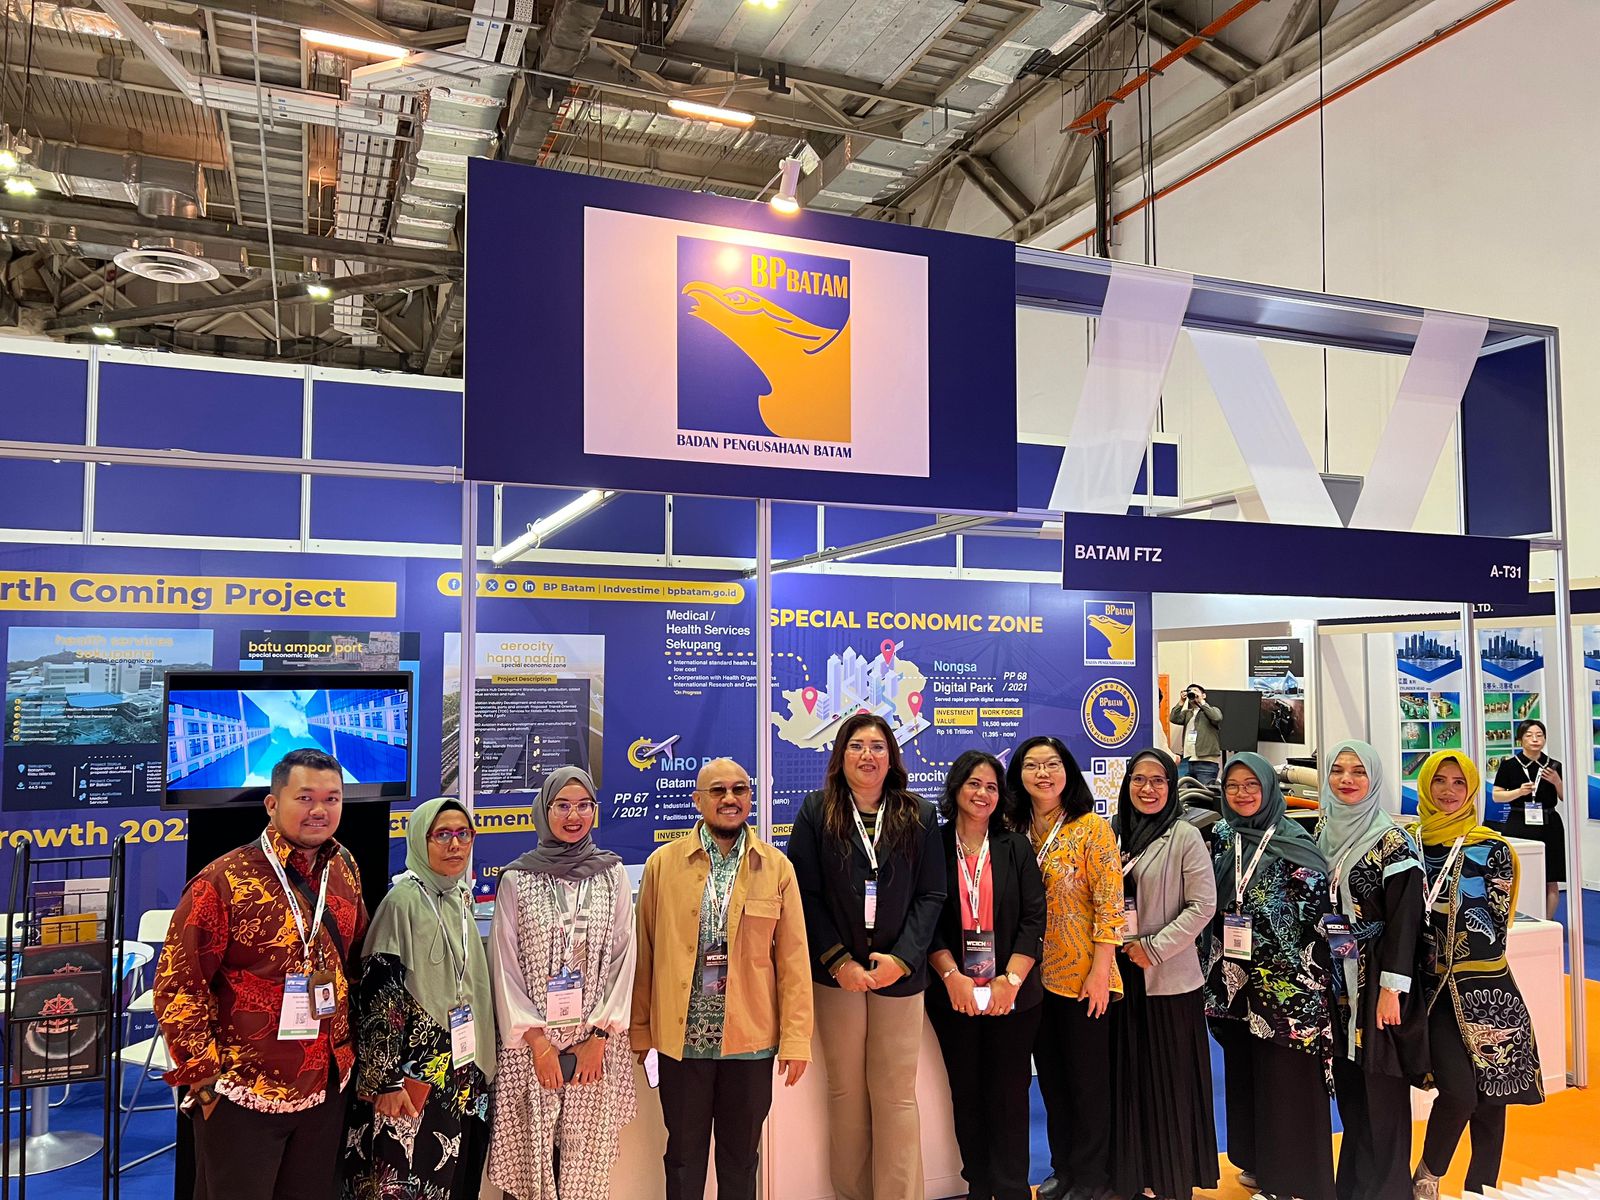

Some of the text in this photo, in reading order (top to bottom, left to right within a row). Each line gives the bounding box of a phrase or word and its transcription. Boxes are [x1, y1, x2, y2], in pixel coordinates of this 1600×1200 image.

[751, 254, 848, 298] BP BATAM
[677, 434, 852, 458] BADAN PENGUSAHAAN BATAM
[1075, 544, 1162, 562] BATAM FTZ
[1490, 564, 1521, 578] A-T31
[69, 578, 213, 610] Coming
[225, 582, 346, 612] Project
[543, 582, 557, 591] BP
[561, 584, 595, 592] Batam
[603, 585, 660, 595] Indvestime
[667, 587, 737, 598] bpbatam.go.id
[1105, 604, 1133, 616] BP BATAM
[1472, 603, 1494, 612] LTD.
[666, 610, 708, 621] Medical
[770, 609, 1043, 633] SPECIAL ECONOMIC ZONE
[666, 624, 750, 635] Health Services
[54, 634, 106, 647] health
[666, 639, 721, 652] Sekupang
[248, 641, 363, 656] batu ampar port
[500, 641, 554, 656] aerocity
[487, 653, 566, 665] hang nadim
[934, 660, 977, 674] Nongsa
[1003, 671, 1027, 680] PP 68
[933, 682, 993, 694] Digital Park
[1008, 683, 1027, 691] 2021
[1100, 697, 1108, 706] BP
[661, 757, 697, 771] MRO
[656, 778, 695, 789] (Batam
[614, 792, 649, 804] PP 67
[773, 798, 790, 806] (MRO)
[619, 806, 648, 818] 2021
[120, 818, 188, 844] 202
[773, 825, 793, 834] ORCE
